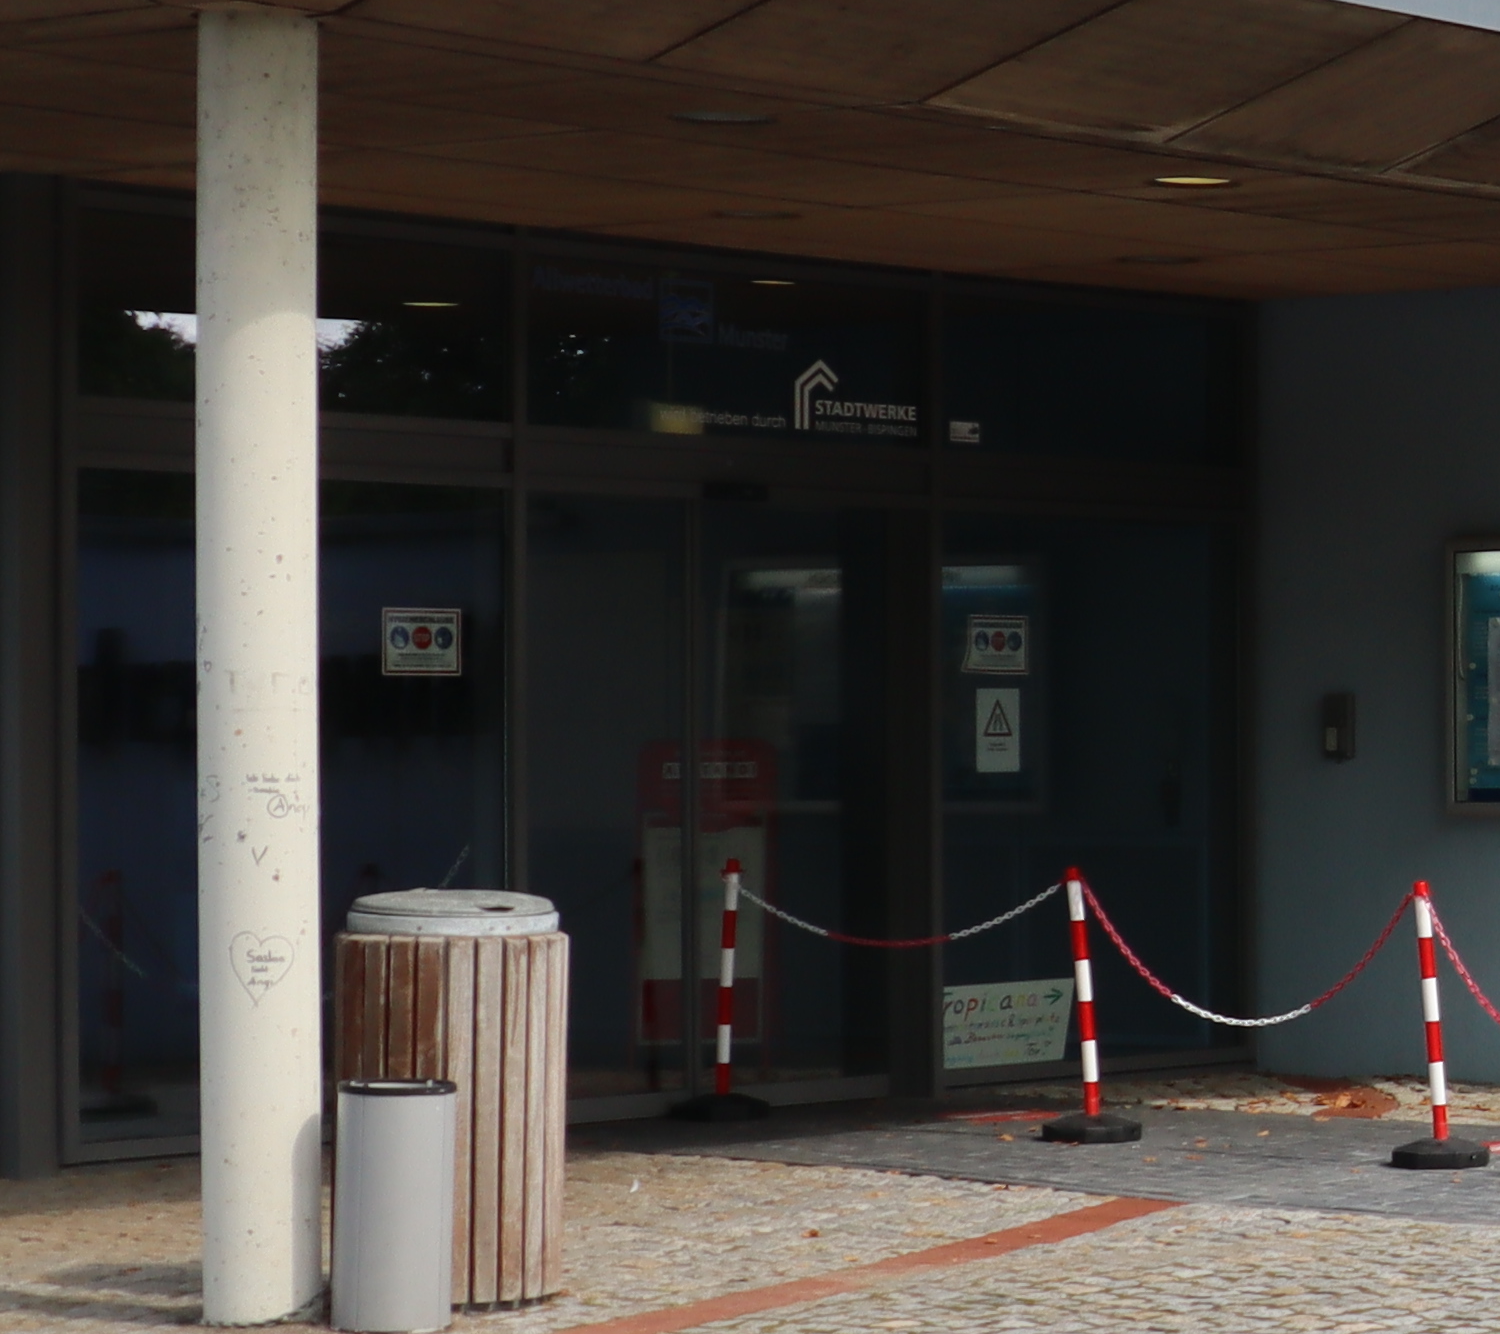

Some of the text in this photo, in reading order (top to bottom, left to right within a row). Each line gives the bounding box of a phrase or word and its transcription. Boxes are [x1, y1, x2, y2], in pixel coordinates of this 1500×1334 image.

[690, 409, 749, 427] betrieben
[752, 413, 787, 428] durch
[815, 400, 917, 421] STADTWERKE
[943, 992, 1037, 1022] ropicana
